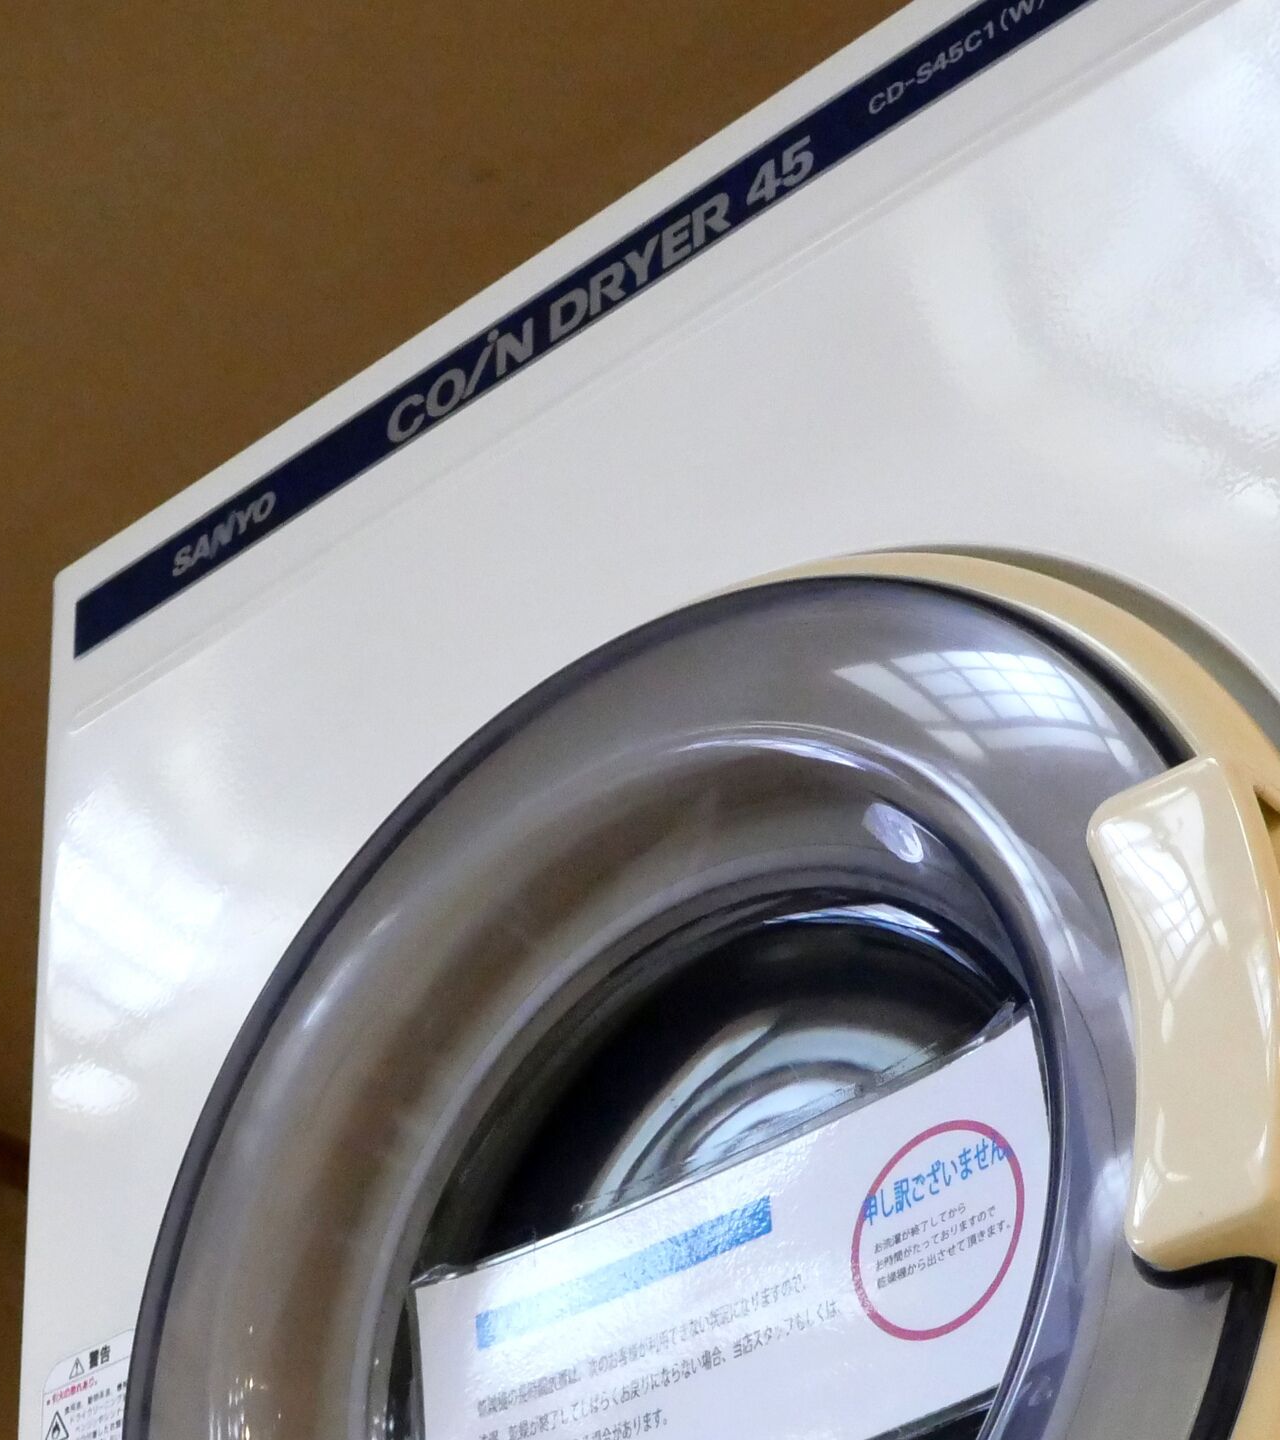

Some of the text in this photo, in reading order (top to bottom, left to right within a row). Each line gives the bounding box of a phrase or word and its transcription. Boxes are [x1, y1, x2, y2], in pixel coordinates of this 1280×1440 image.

[549, 192, 732, 343] DRYER
[746, 135, 815, 206] 45
[172, 491, 276, 576] SANYO
[874, 1202, 967, 1254] お洗濯が終了してから
[876, 1205, 997, 1272] お時間がたっておりますので
